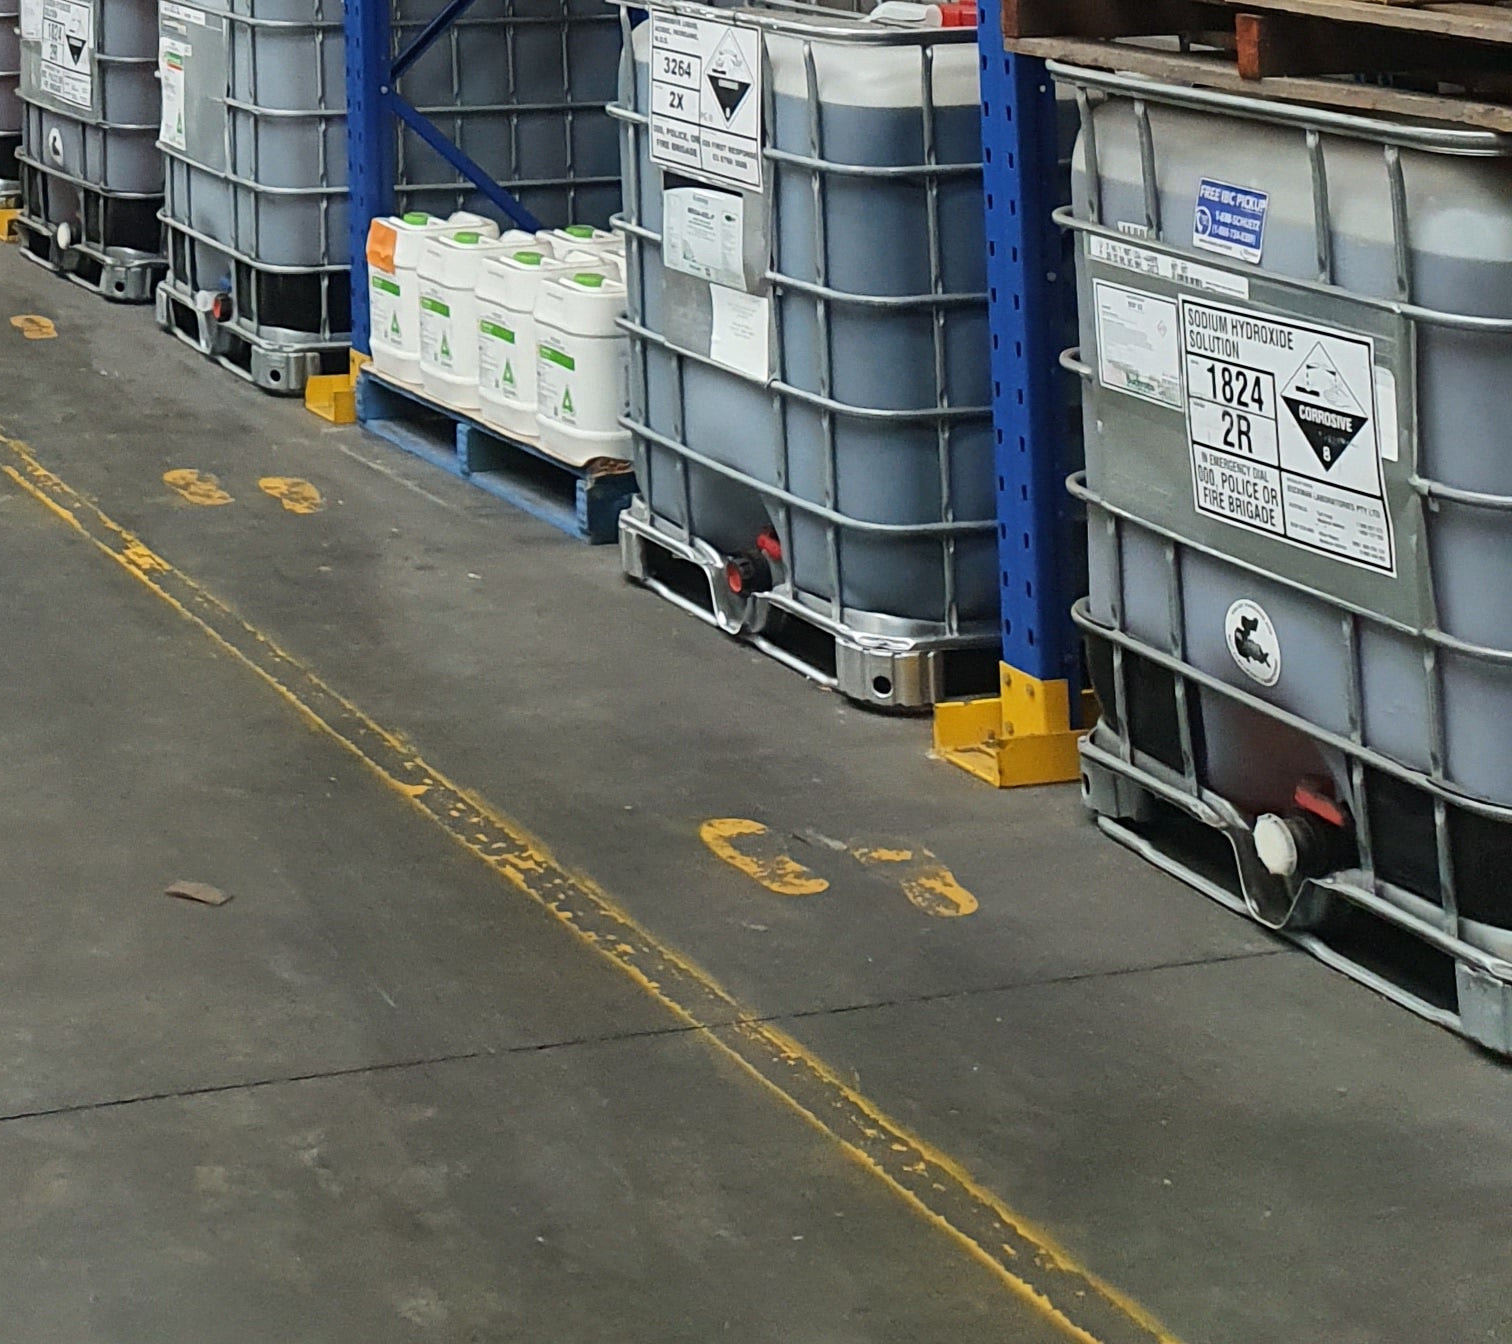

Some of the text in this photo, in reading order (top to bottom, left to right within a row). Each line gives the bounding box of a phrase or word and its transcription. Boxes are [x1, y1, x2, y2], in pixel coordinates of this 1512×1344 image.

[48, 22, 62, 41] 1824
[663, 56, 692, 78] 3264
[668, 91, 684, 111] 2X
[1200, 184, 1221, 202] FREE
[1236, 193, 1266, 213] PICKUP
[1188, 308, 1294, 350] SODIUM HYDROXIDE
[1189, 331, 1239, 360] SOLUTION
[1206, 363, 1264, 412] 1824
[1221, 410, 1253, 454] 2R
[1298, 404, 1353, 433] CORROSIVE
[1201, 451, 1269, 483] IN EMERGENCY DIAL
[1322, 445, 1332, 462] 8
[1220, 470, 1260, 501] POLICE
[1262, 483, 1279, 507] OR
[1203, 486, 1276, 527] FIRE BRIGADE
